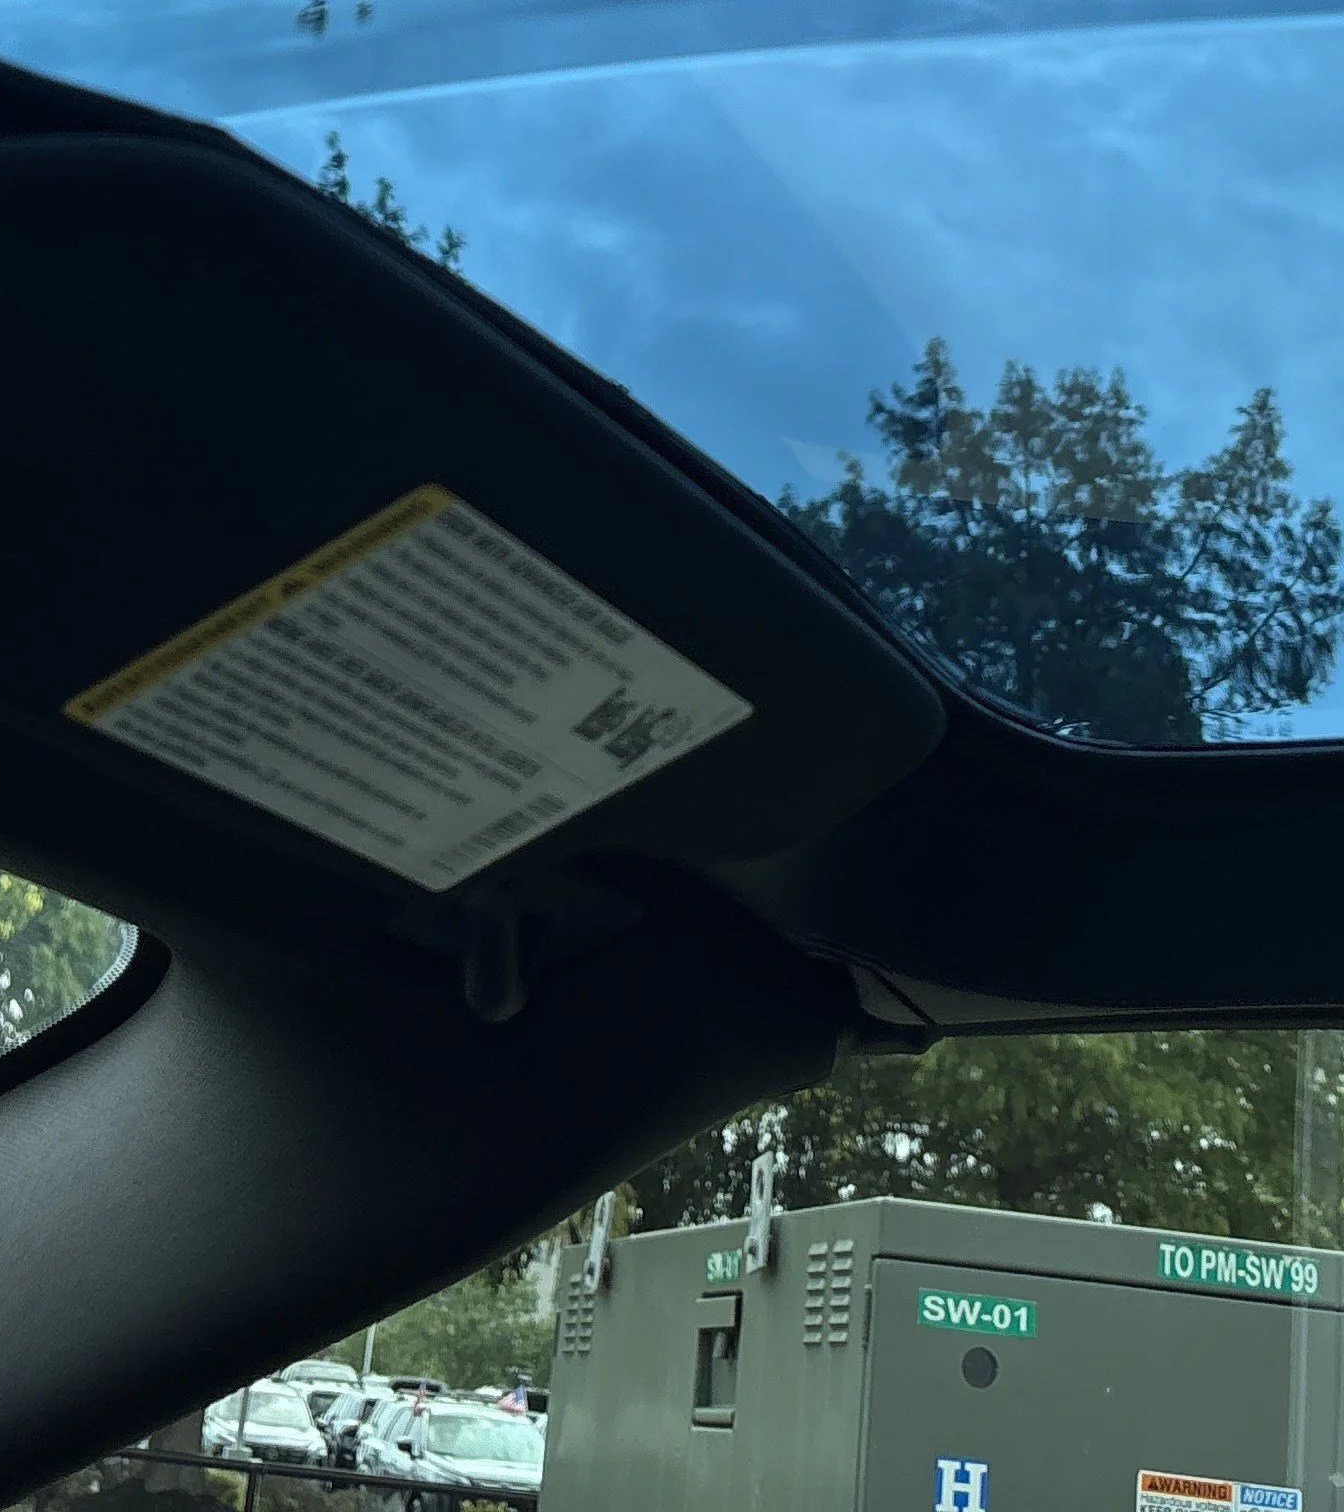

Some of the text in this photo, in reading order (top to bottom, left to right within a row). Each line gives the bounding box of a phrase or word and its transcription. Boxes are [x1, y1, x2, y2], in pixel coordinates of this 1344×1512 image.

[1159, 1243, 1194, 1278] TO
[922, 1294, 1029, 1333] SW-01
[935, 1459, 988, 1512] H
[1158, 1479, 1227, 1500] WARNING
[1243, 1487, 1295, 1508] NOTICE
